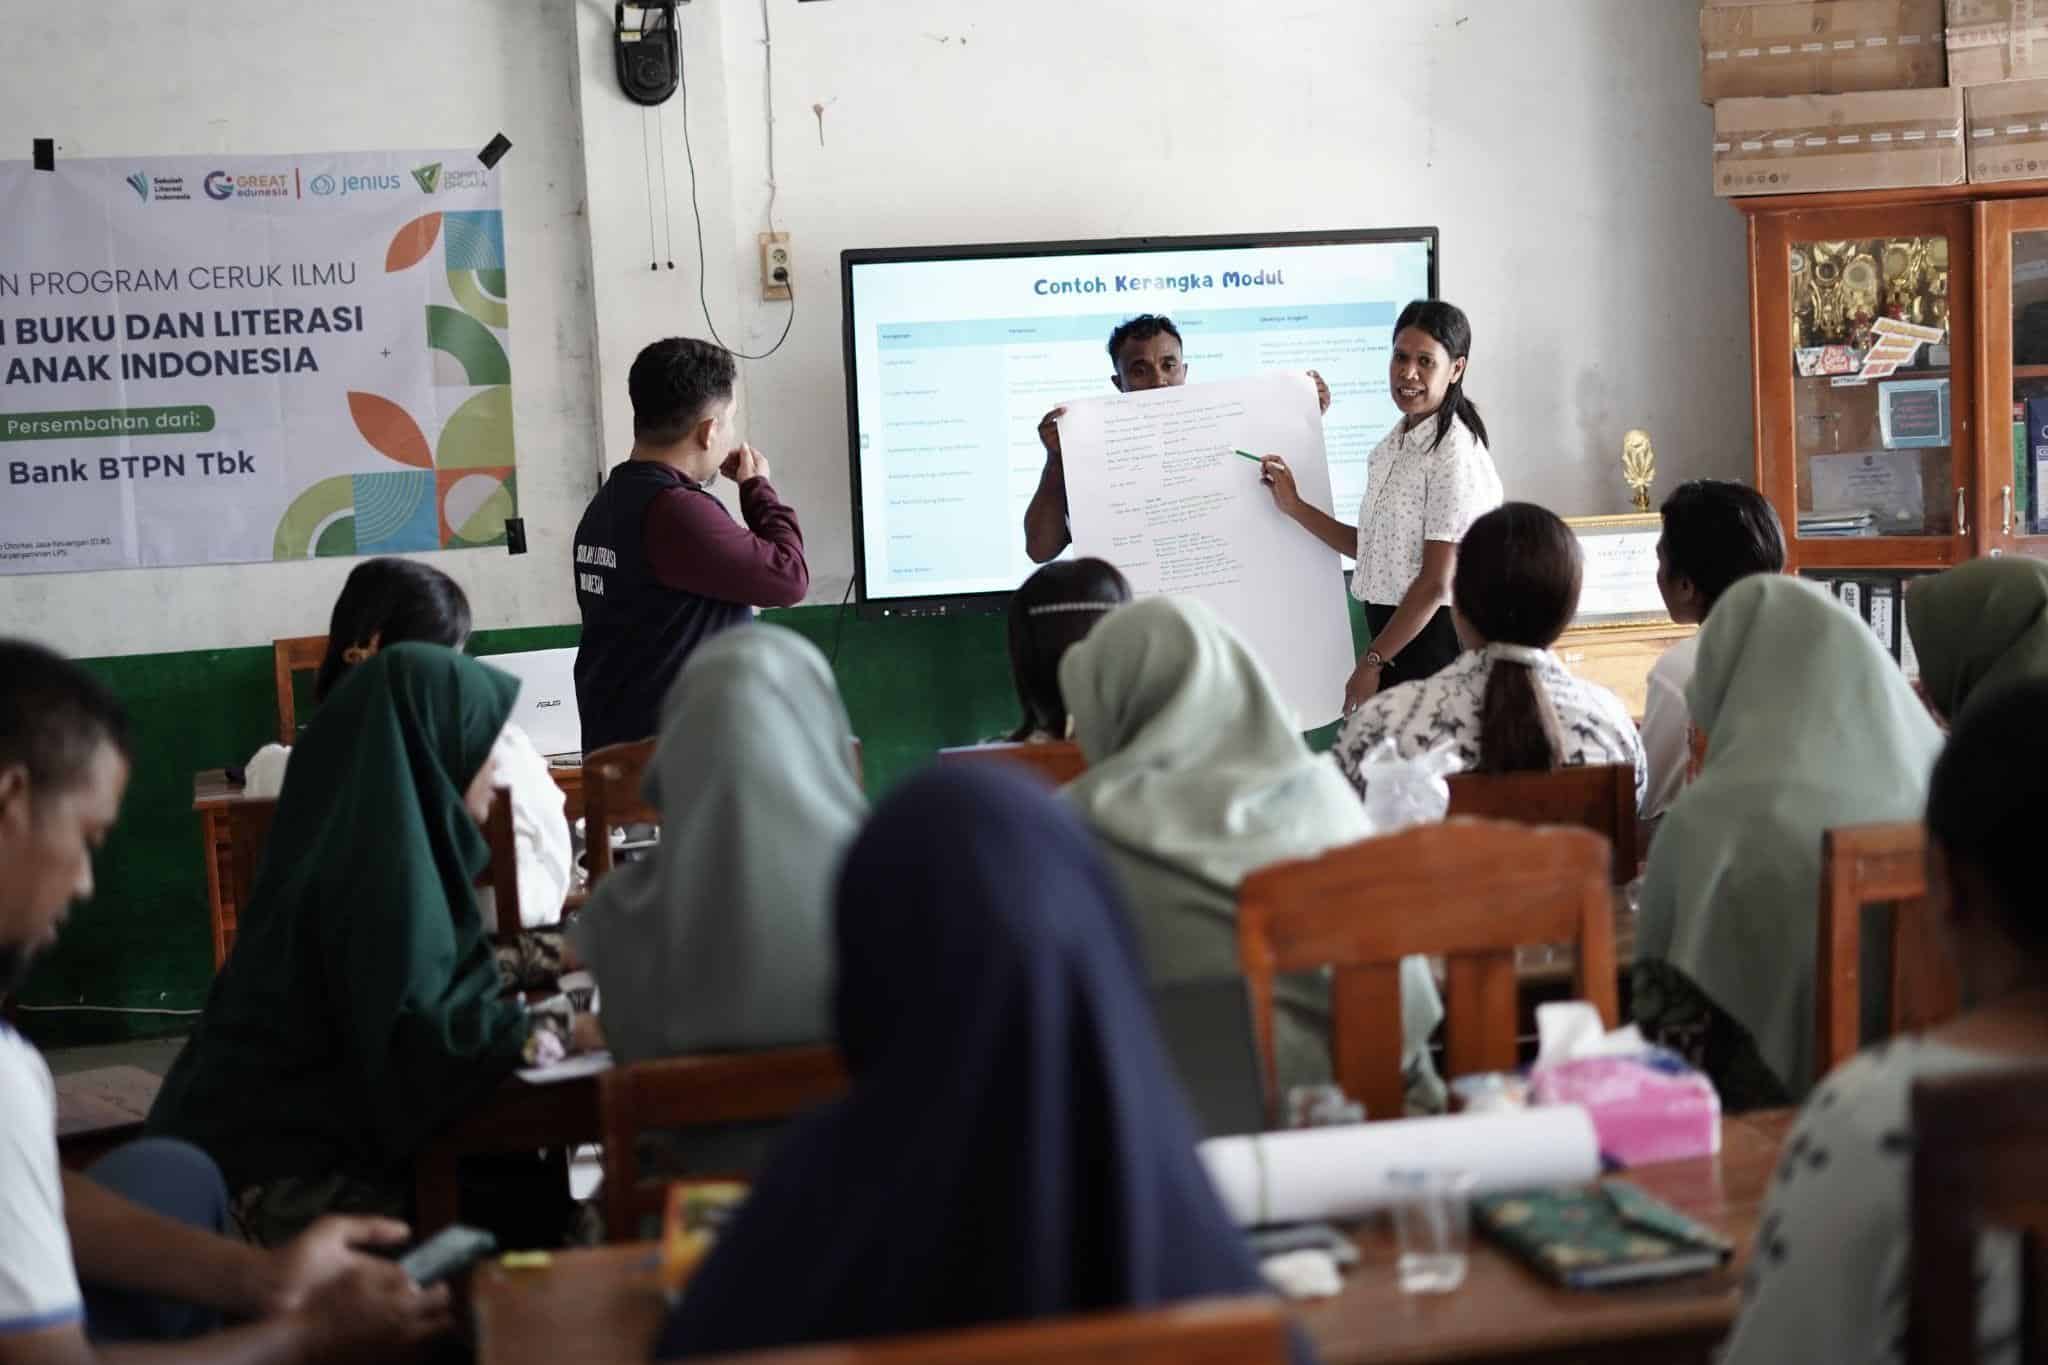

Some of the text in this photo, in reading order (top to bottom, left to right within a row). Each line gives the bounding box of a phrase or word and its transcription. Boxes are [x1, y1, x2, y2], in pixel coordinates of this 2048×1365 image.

[236, 175, 288, 188] GREAT
[237, 187, 288, 197] edunesia
[340, 174, 400, 194] jenius
[31, 268, 178, 296] PROGRAM
[188, 264, 282, 290] CERUK
[292, 261, 356, 287] ILMU
[1034, 269, 1285, 295] Contoh Kerangka Modul
[15, 315, 115, 345] BUKU
[126, 310, 205, 341] DAN
[213, 305, 363, 338] LITERASI
[5, 347, 319, 384] ANAK INDONESIA
[7, 411, 201, 434] Persembahan dari:
[8, 450, 255, 484] Bank BTPN Tbk
